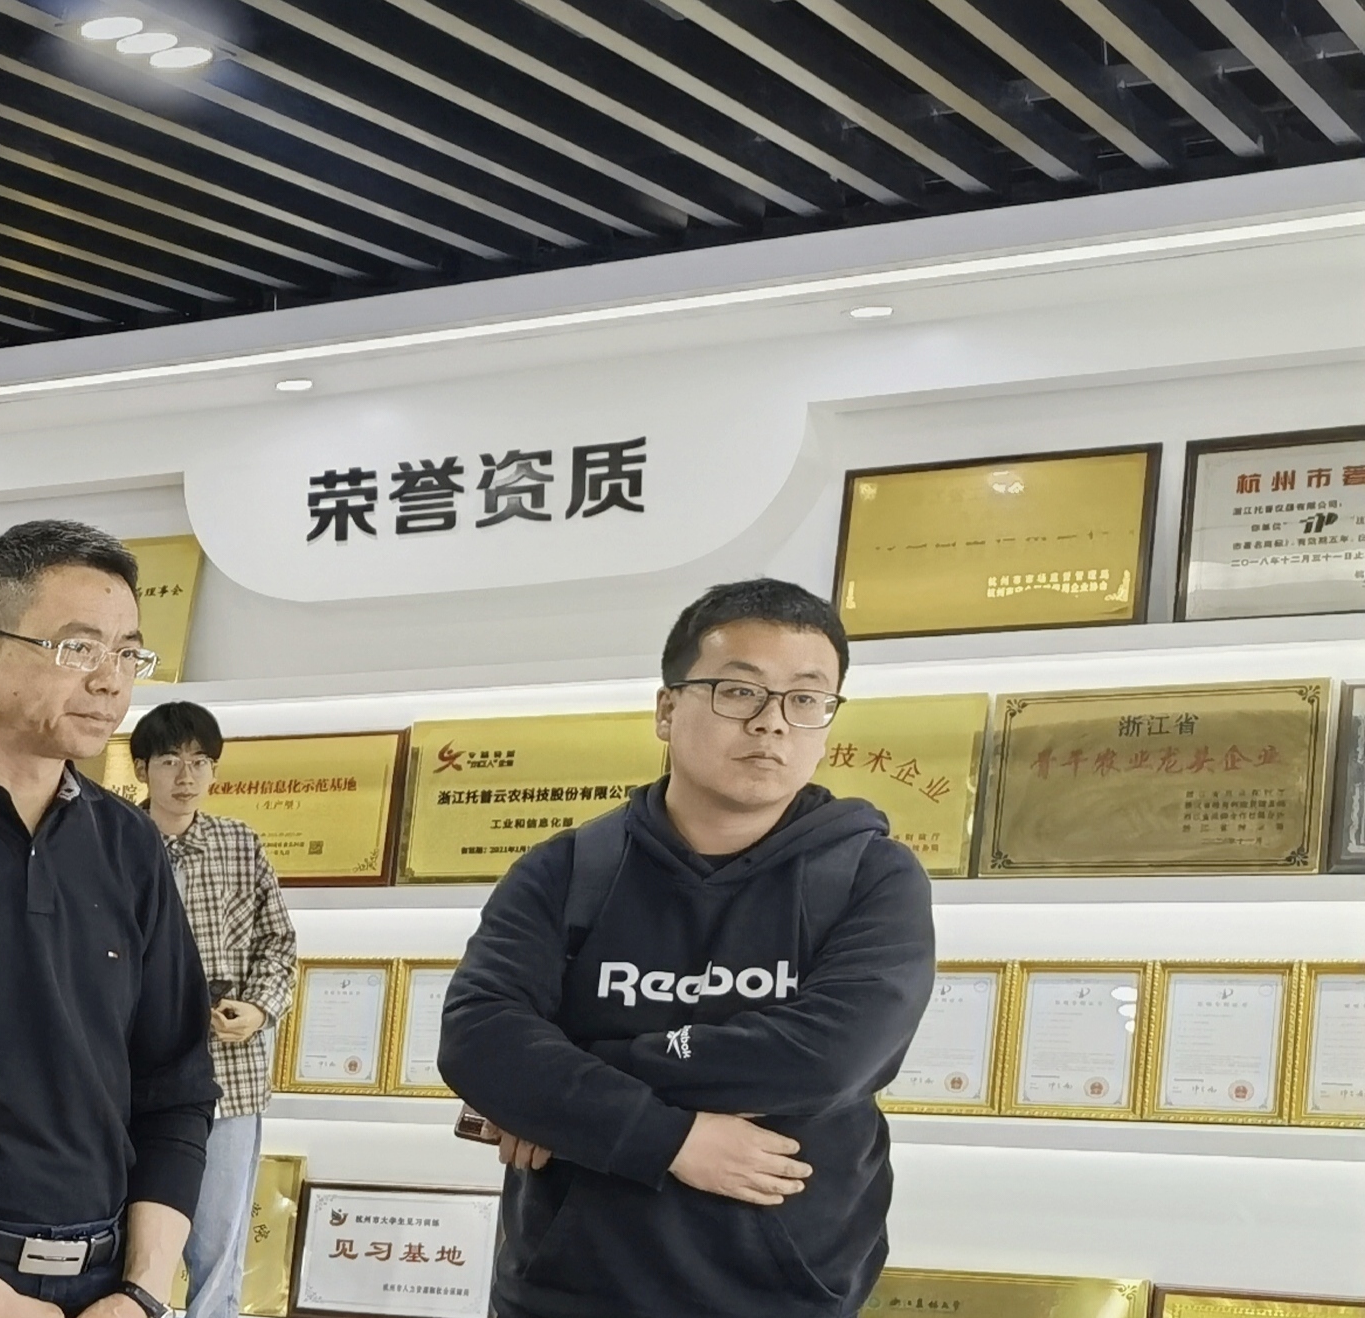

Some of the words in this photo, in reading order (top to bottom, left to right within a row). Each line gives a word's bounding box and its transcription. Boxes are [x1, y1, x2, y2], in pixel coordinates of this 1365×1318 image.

[306, 435, 647, 542] 荣誉资质
[1118, 712, 1200, 738] 浙江省
[829, 742, 951, 804] 技术企业
[490, 817, 574, 830] 工业和信息化部
[328, 1238, 467, 1266] 见习基地
